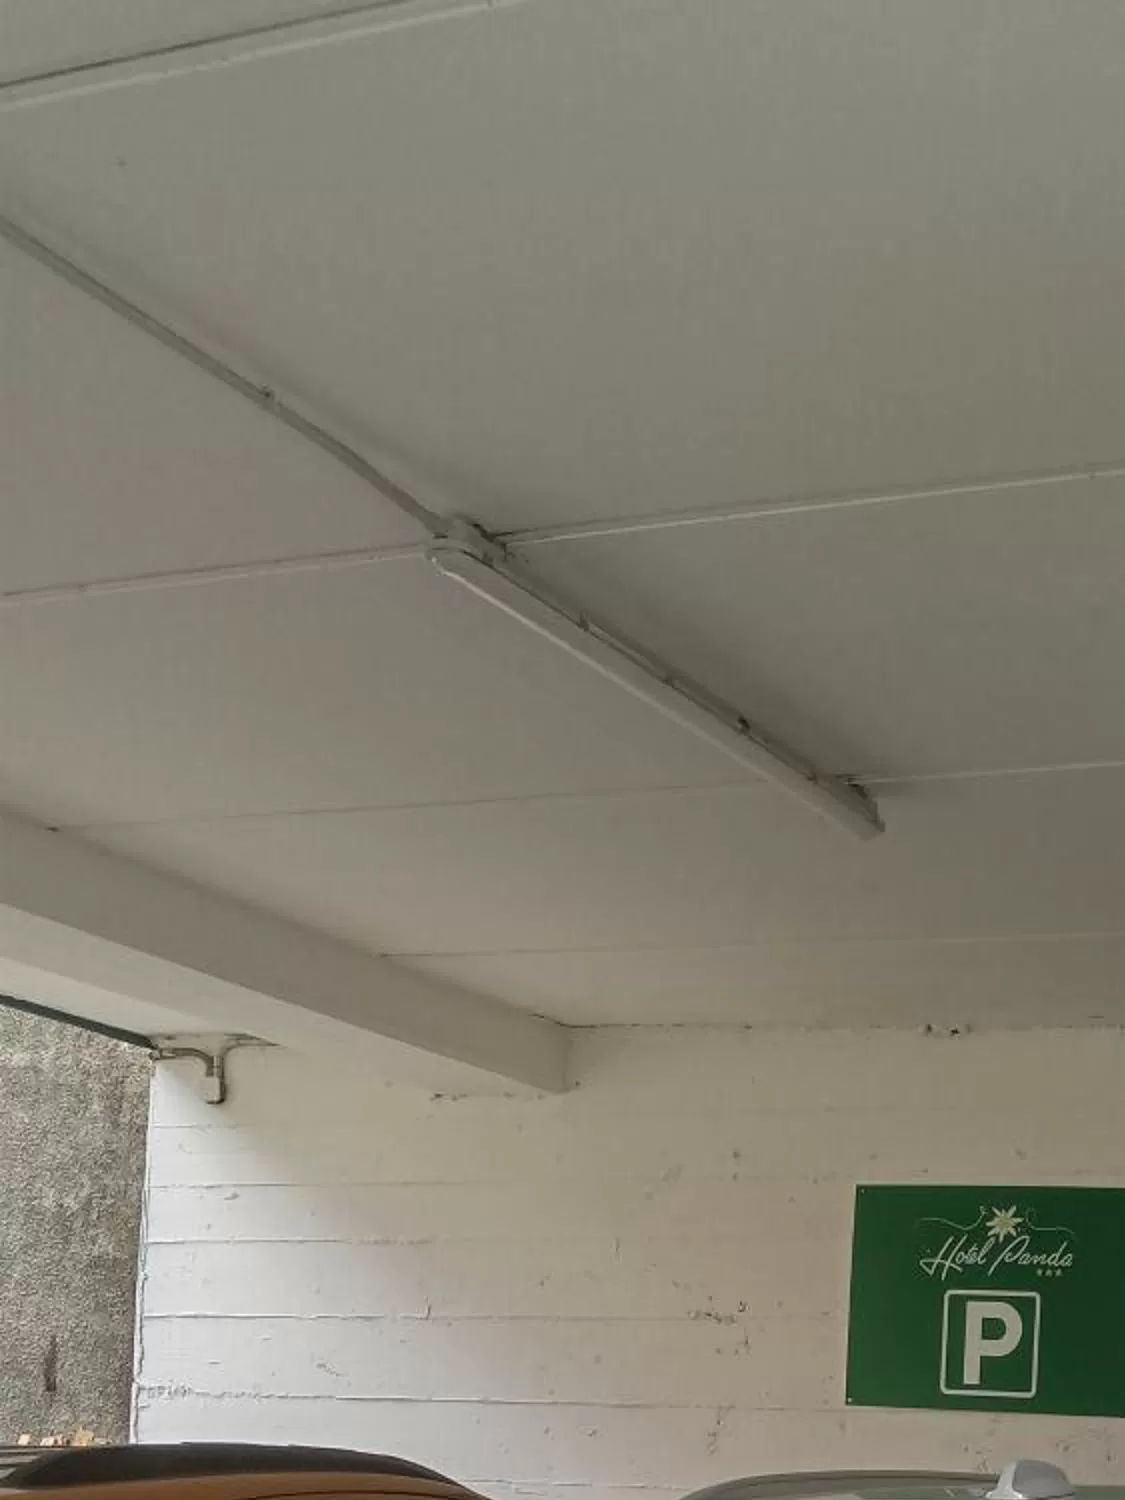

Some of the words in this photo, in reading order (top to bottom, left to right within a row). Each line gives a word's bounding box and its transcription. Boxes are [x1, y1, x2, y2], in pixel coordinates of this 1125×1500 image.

[919, 1235, 996, 1280] Hotel
[988, 1236, 1073, 1276] Panda
[963, 1301, 1023, 1385] P
